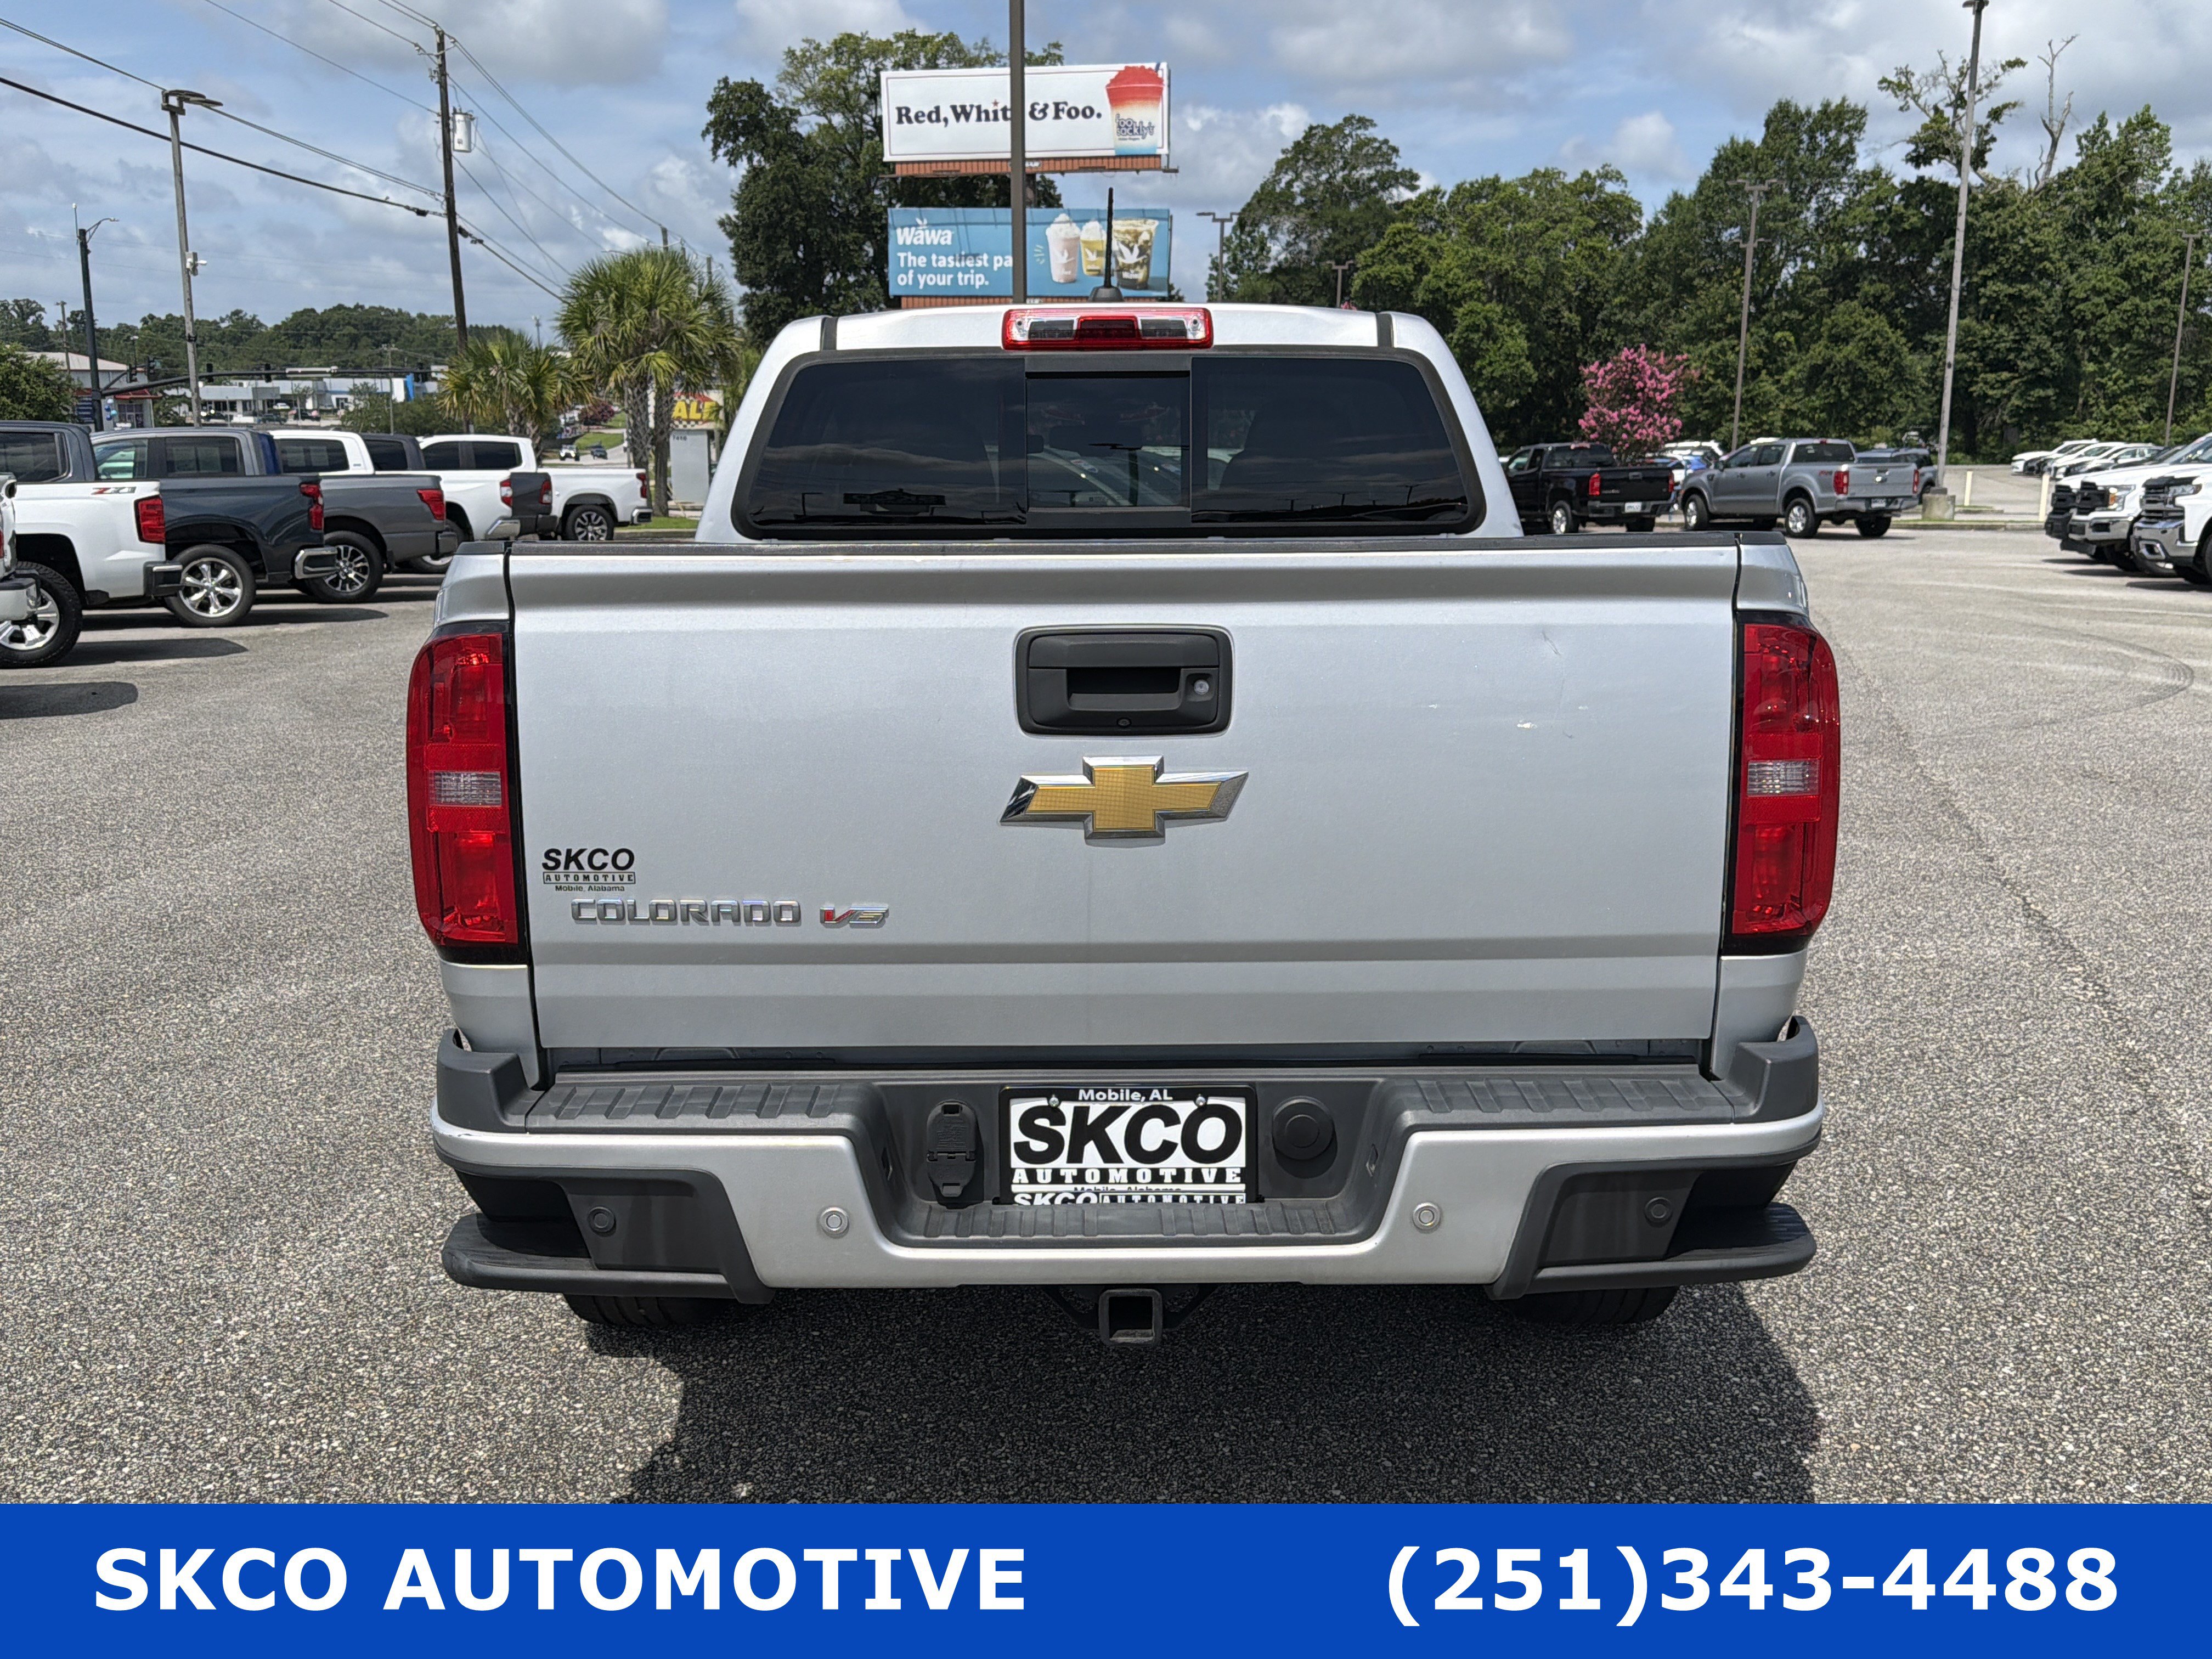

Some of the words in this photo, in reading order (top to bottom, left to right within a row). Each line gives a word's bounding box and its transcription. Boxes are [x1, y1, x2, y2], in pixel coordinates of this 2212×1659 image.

[895, 105, 949, 127] Red,
[950, 99, 1011, 122] Whit
[1029, 101, 1049, 121] &
[1052, 101, 1102, 120] Foo.
[896, 226, 952, 245] Wawa
[897, 251, 927, 267] The
[931, 250, 989, 268] tastiest
[994, 255, 1013, 271] pa
[898, 269, 914, 286] of
[917, 274, 954, 290] your
[957, 269, 989, 289] trip.
[671, 400, 717, 420] ALE
[542, 848, 635, 871] SKCO
[571, 898, 801, 925] COLORADO
[820, 904, 889, 928] V6
[1079, 1089, 1146, 1102] Mobile,
[1149, 1090, 1172, 1101] AL
[1013, 1103, 1243, 1165] SKCO
[1012, 1168, 1241, 1184] AUTOMOTIVE
